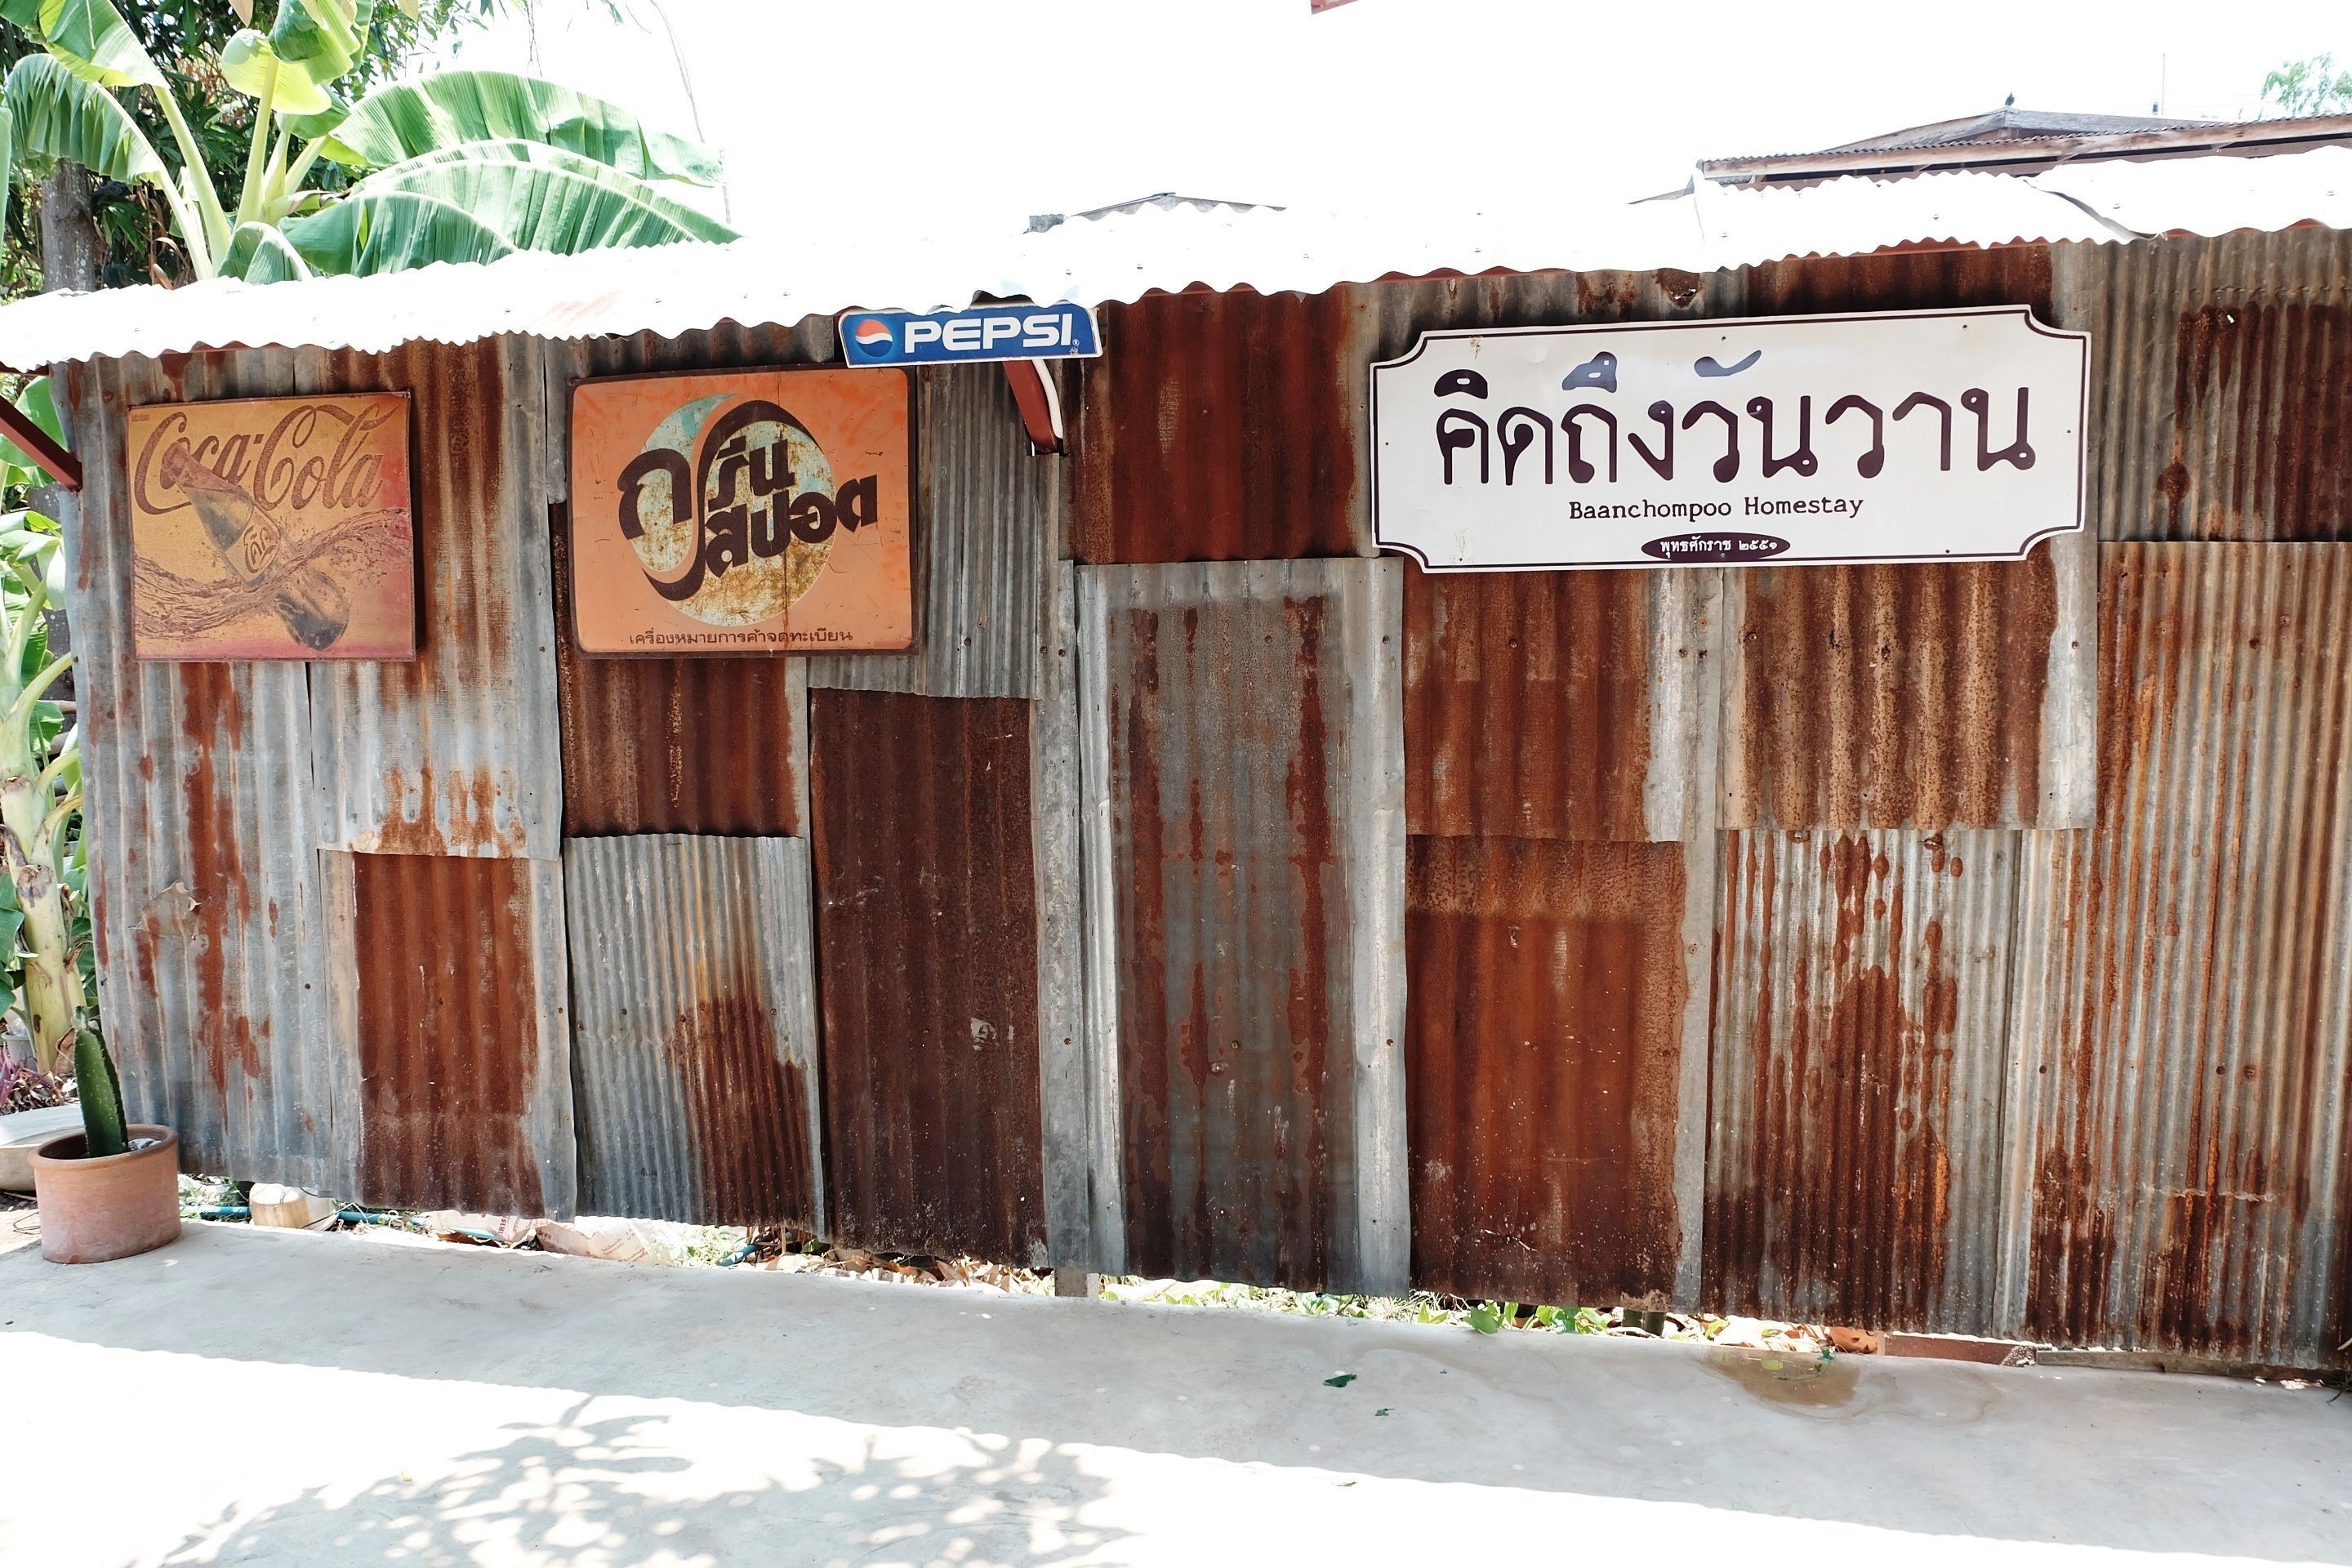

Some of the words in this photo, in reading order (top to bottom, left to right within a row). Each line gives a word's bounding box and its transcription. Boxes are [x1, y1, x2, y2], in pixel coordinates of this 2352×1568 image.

[904, 314, 1073, 353] PEPSI
[1434, 350, 2036, 486] คิดถึงวันวาน
[134, 403, 400, 515] Coca-Cola
[1569, 499, 1732, 523] Baanchompoo
[1744, 497, 1864, 519] Homestay
[1659, 535, 1732, 559] พุทธศักราช
[629, 627, 853, 644] เครื่องหมายการค้าจดทะเบียน
